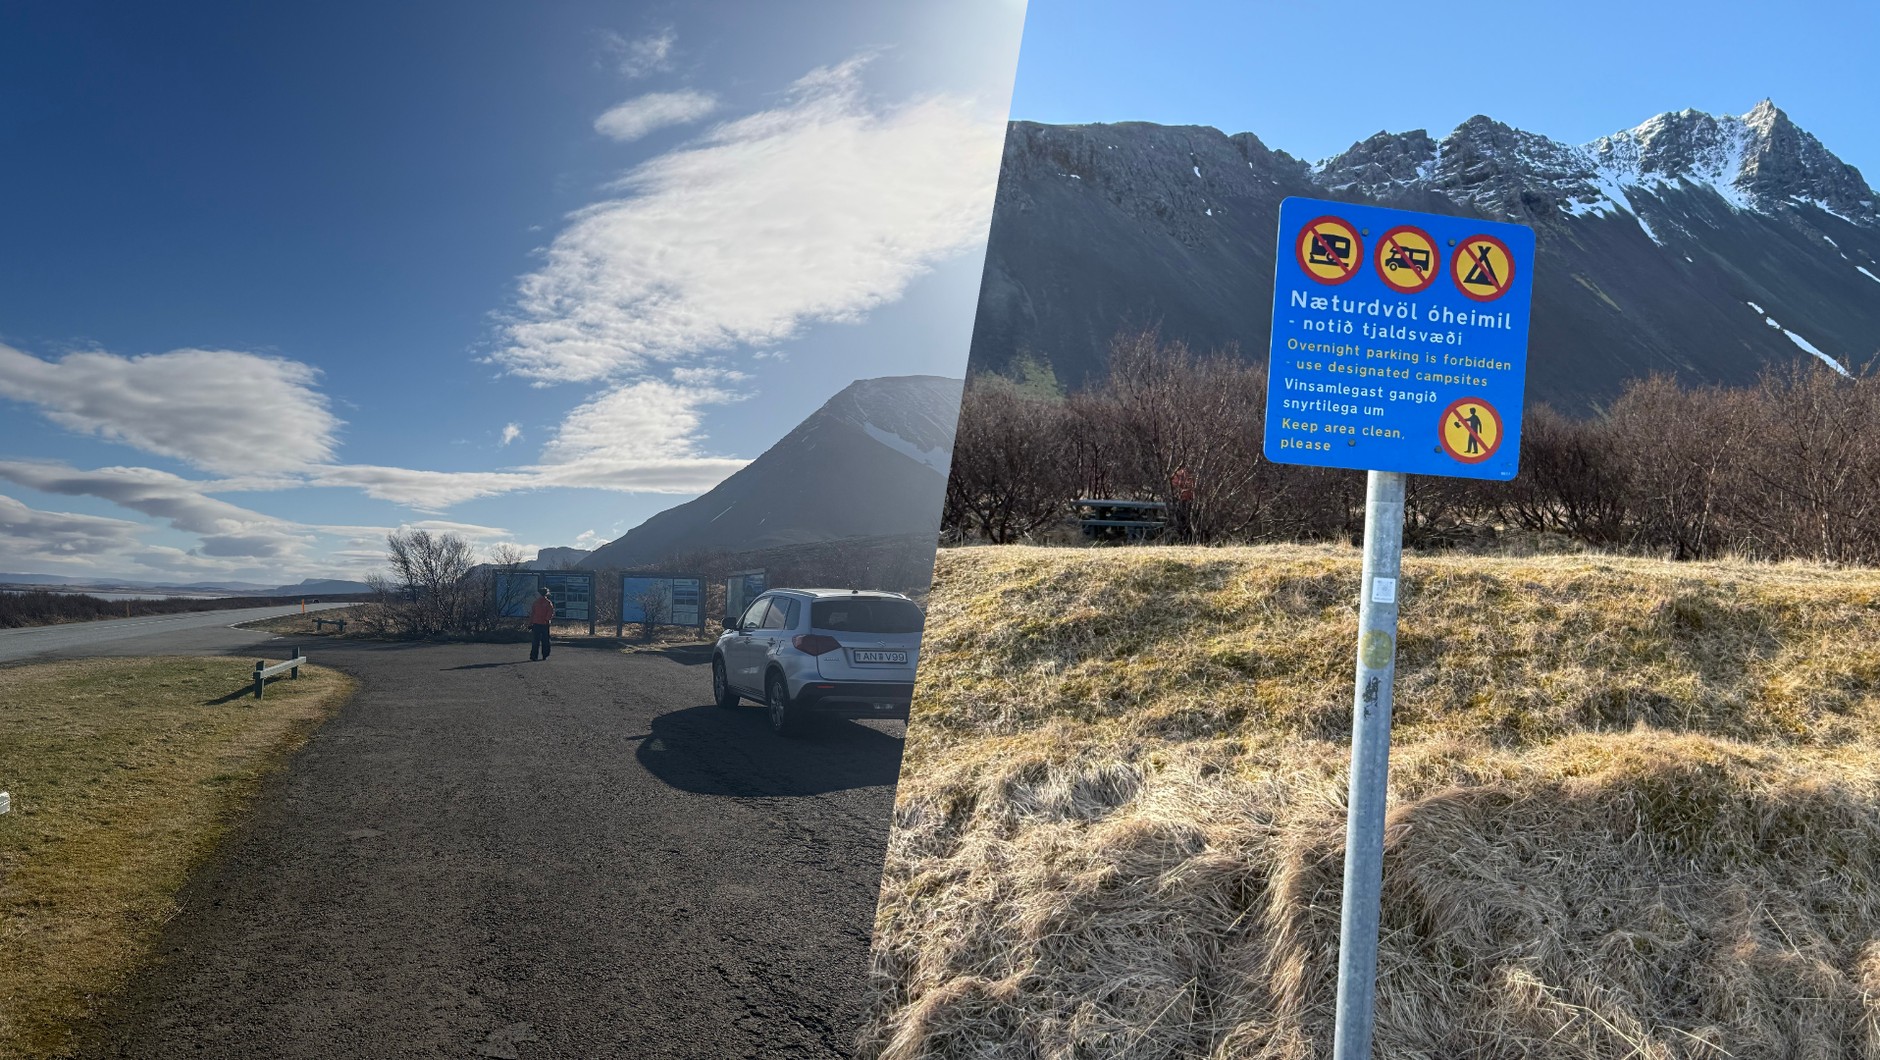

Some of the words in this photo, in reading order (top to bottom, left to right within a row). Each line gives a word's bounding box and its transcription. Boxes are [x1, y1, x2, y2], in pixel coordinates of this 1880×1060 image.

[1291, 290, 1417, 320] Næturdvöl
[1429, 305, 1512, 330] óheimil
[1303, 319, 1354, 334] notið
[1363, 322, 1463, 346] tjaldsvæði
[1287, 338, 1360, 357] Overnight
[1366, 349, 1419, 364] parking
[1425, 351, 1437, 364] is
[1443, 354, 1512, 371] forbidden
[1296, 361, 1322, 371] use
[1328, 362, 1409, 380] designated
[1416, 373, 1488, 388] campsites
[1284, 377, 1383, 398] Vinsamlegast
[1389, 390, 1437, 404] gangið
[1283, 399, 1358, 416] snyrtilega
[1364, 406, 1384, 416] um
[1282, 418, 1318, 434] Keep
[1324, 424, 1355, 435] area
[1280, 437, 1331, 452] please
